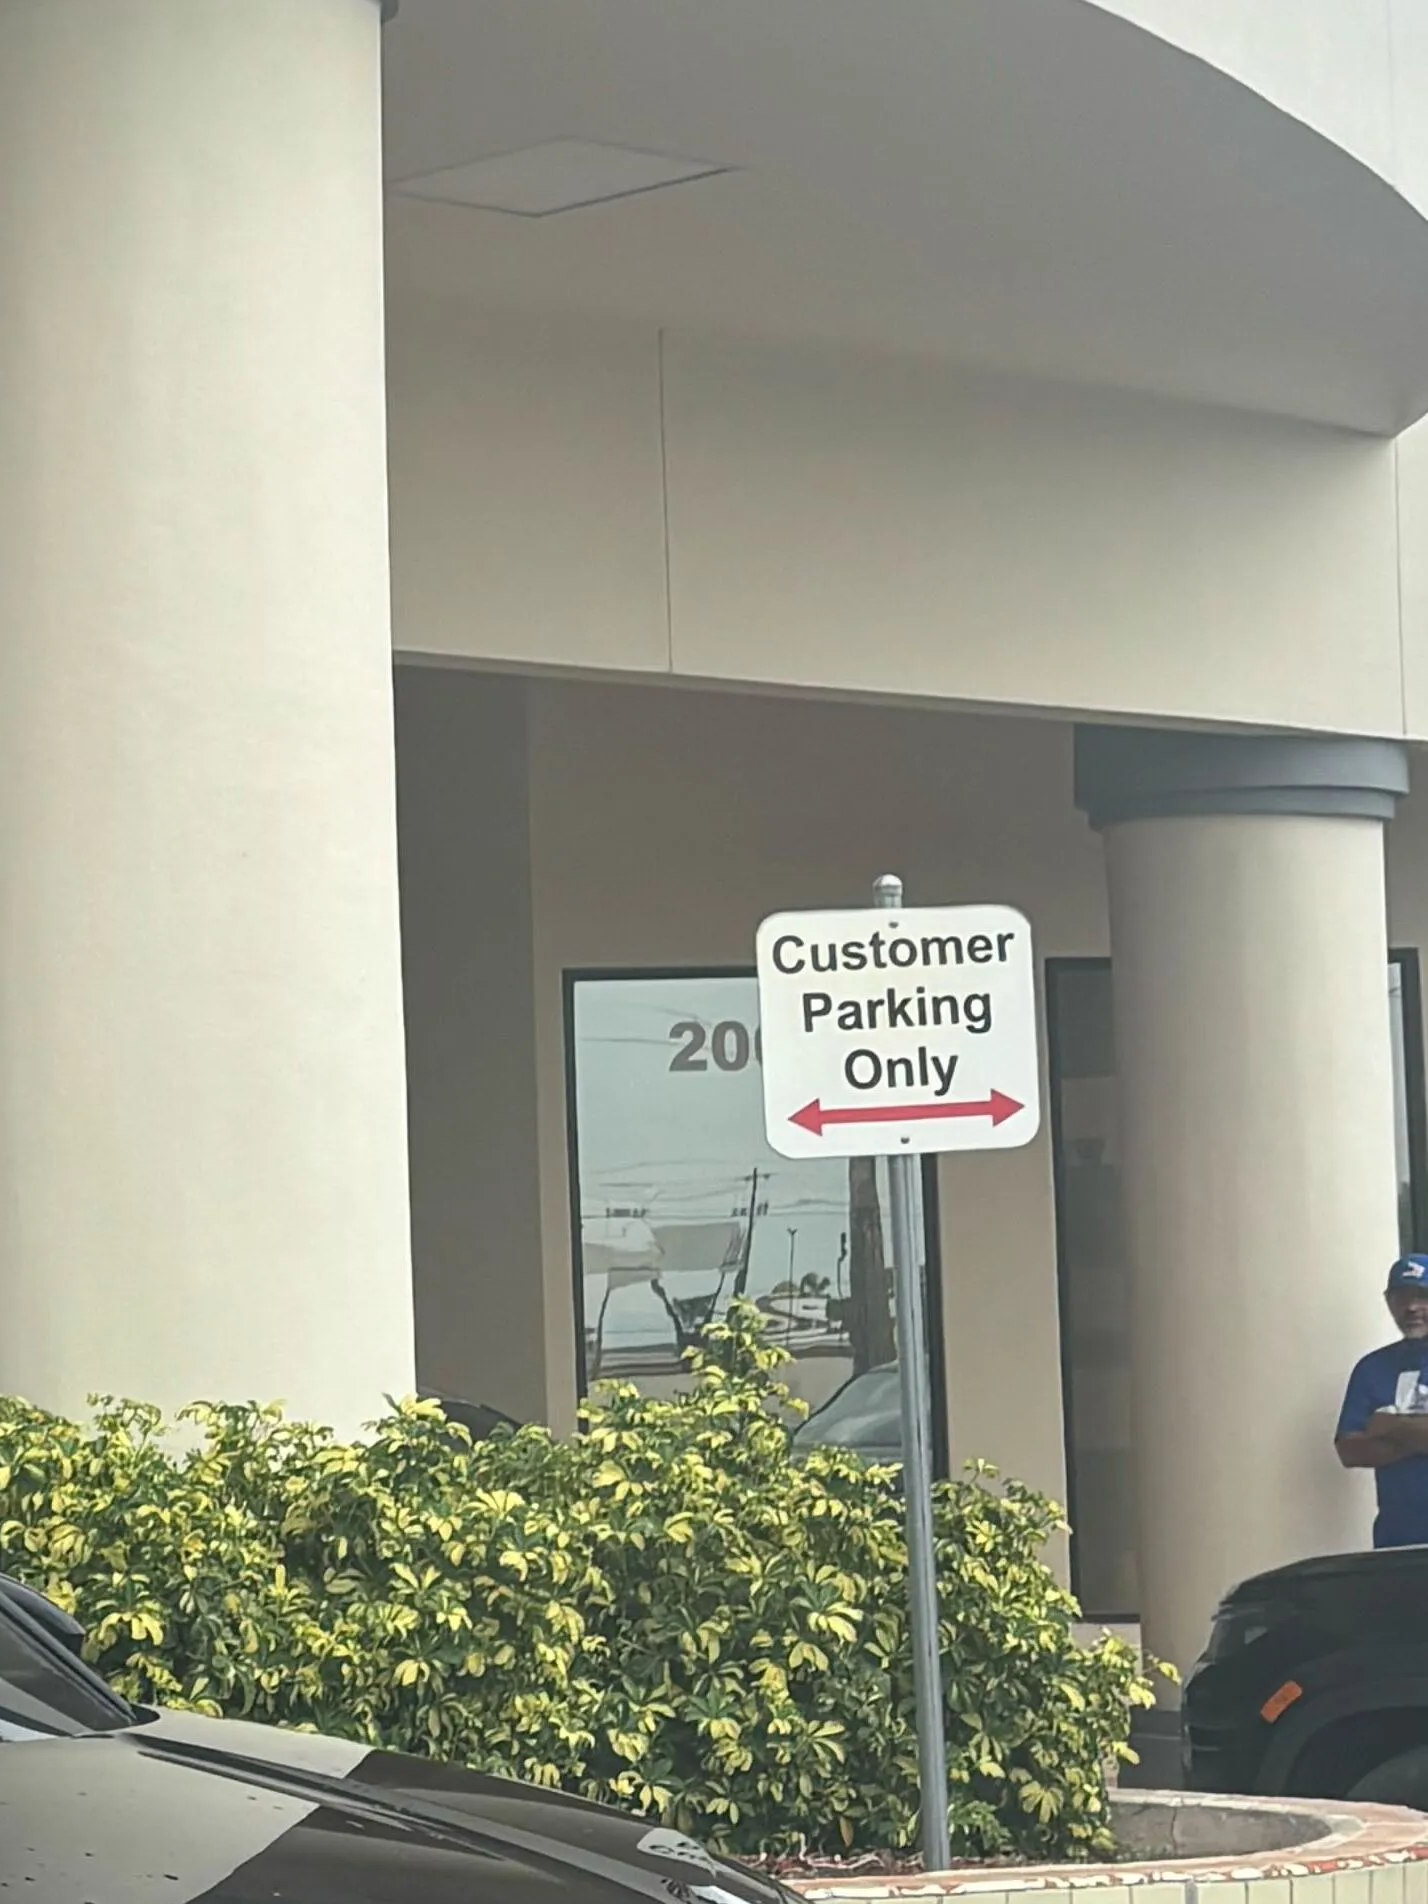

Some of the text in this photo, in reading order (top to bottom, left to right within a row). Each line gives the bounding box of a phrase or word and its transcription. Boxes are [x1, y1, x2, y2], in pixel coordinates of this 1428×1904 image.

[773, 931, 1014, 974] Customer
[803, 987, 992, 1033] Parking
[669, 1021, 762, 1072] 20
[845, 1046, 958, 1096] Only
